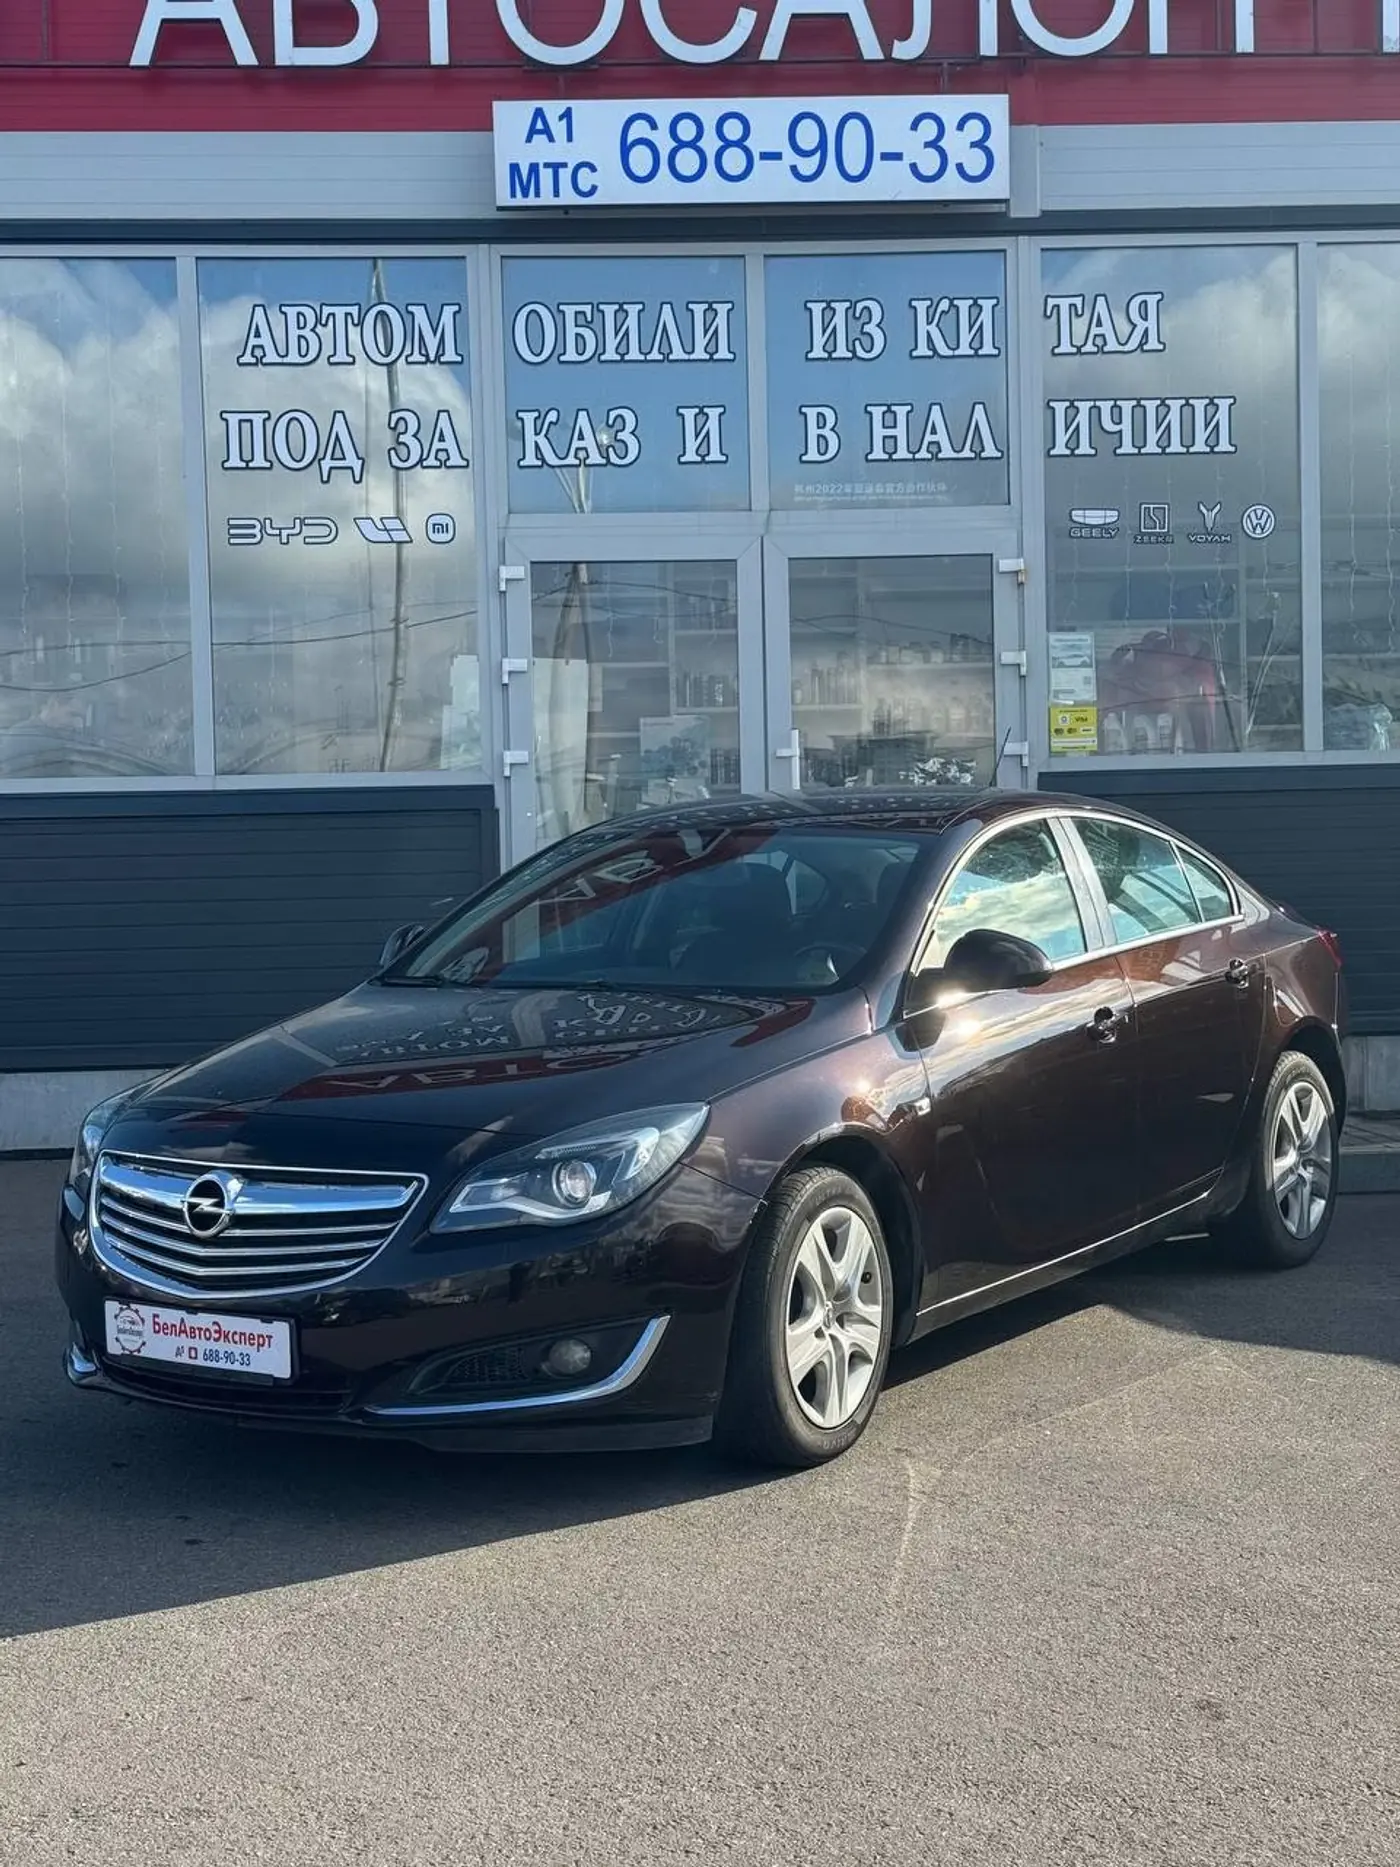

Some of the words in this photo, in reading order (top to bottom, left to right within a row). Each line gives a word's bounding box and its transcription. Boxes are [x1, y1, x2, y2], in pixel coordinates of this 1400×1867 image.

[619, 110, 995, 184] 688-90-33
[508, 160, 598, 199] МТС
[805, 297, 886, 361] ИЗ
[220, 409, 365, 484] ПОД
[678, 405, 728, 464] И
[800, 403, 840, 463] В
[227, 516, 339, 546] BYD
[1069, 526, 1119, 538] GEELY
[1188, 532, 1232, 544] VOYAH
[152, 1313, 273, 1352] БелАвтоЭксперт
[202, 1348, 251, 1367] 688-90-33
